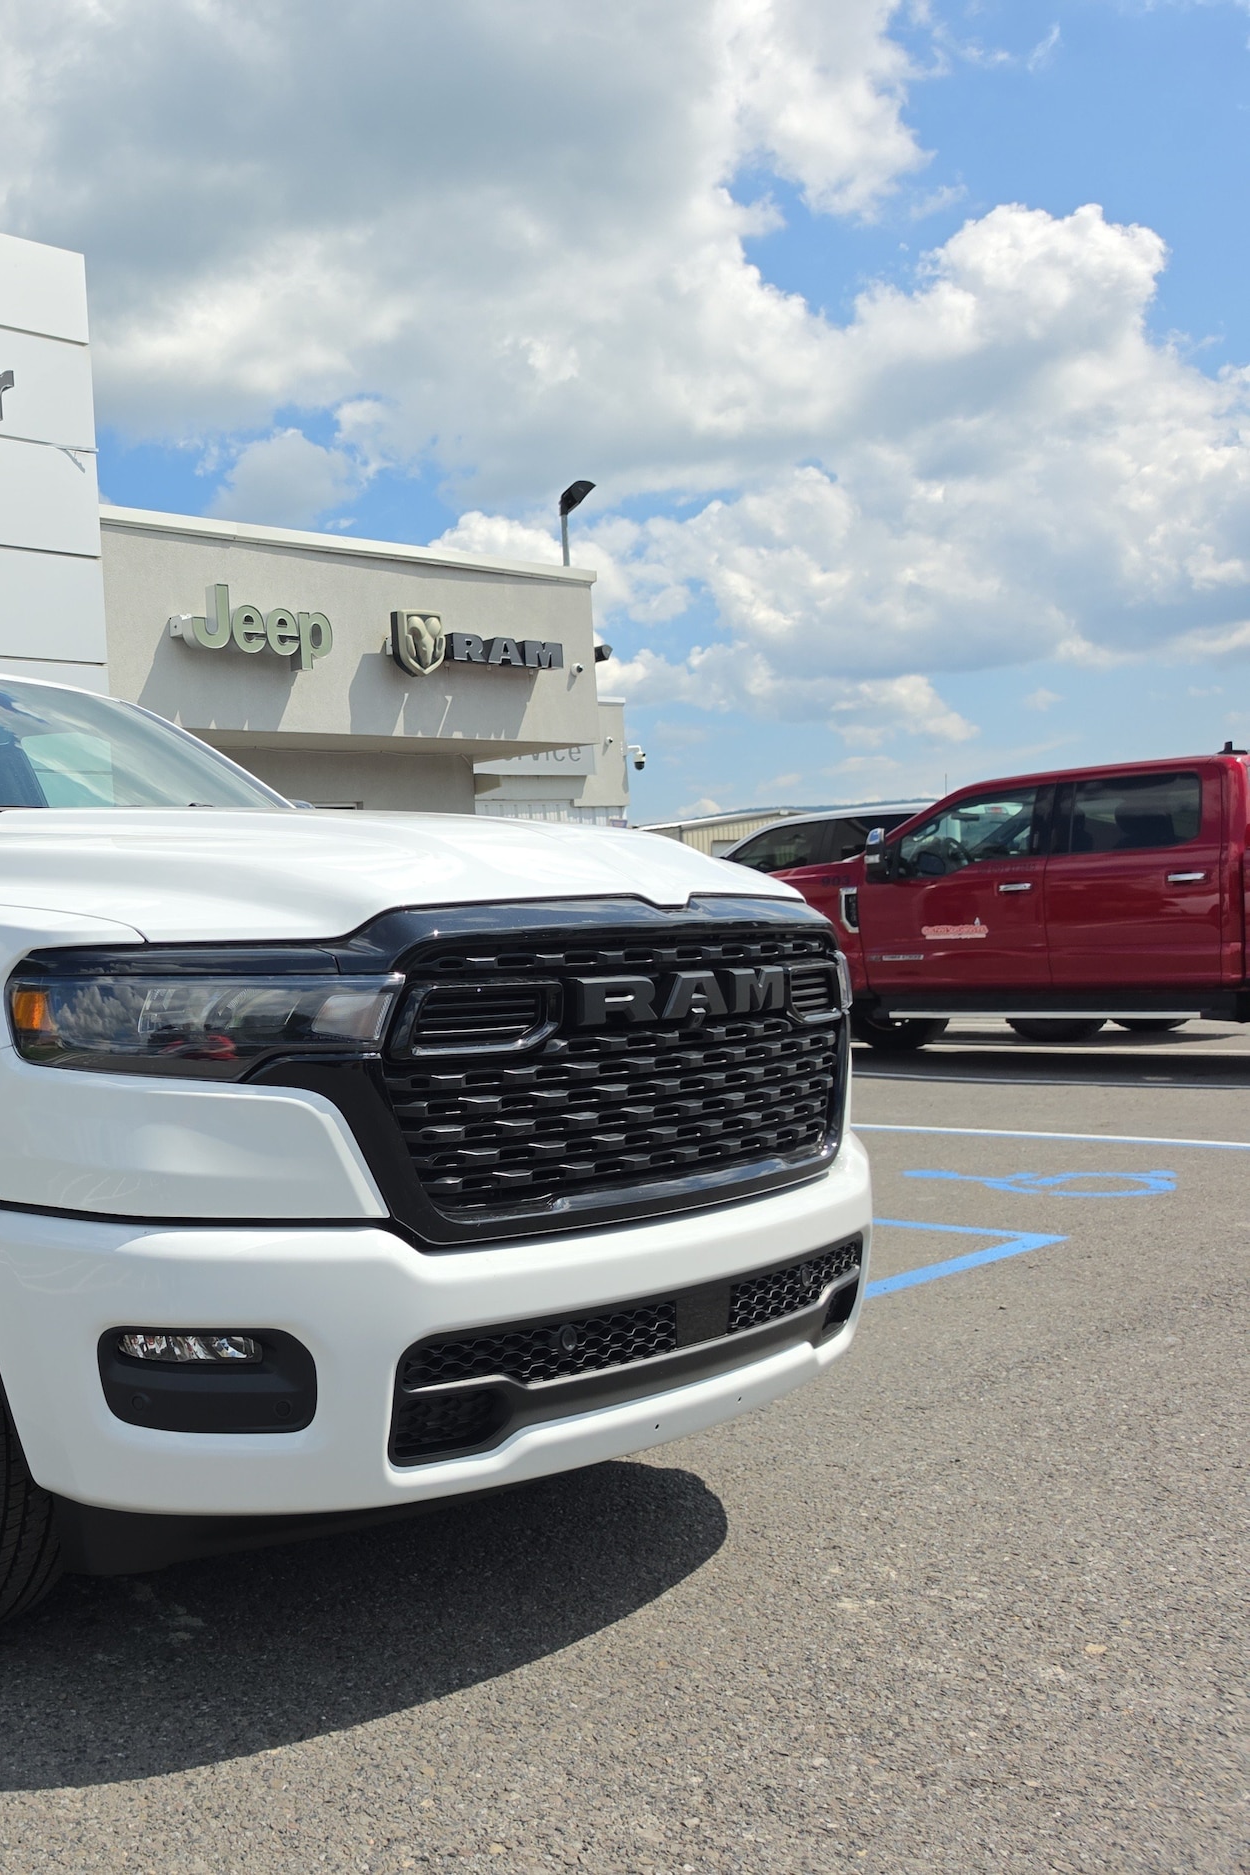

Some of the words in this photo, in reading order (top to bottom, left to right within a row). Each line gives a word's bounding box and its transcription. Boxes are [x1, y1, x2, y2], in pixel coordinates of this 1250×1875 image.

[184, 583, 334, 672] Jeep
[449, 631, 564, 670] RAM
[566, 965, 785, 1026] RAM
